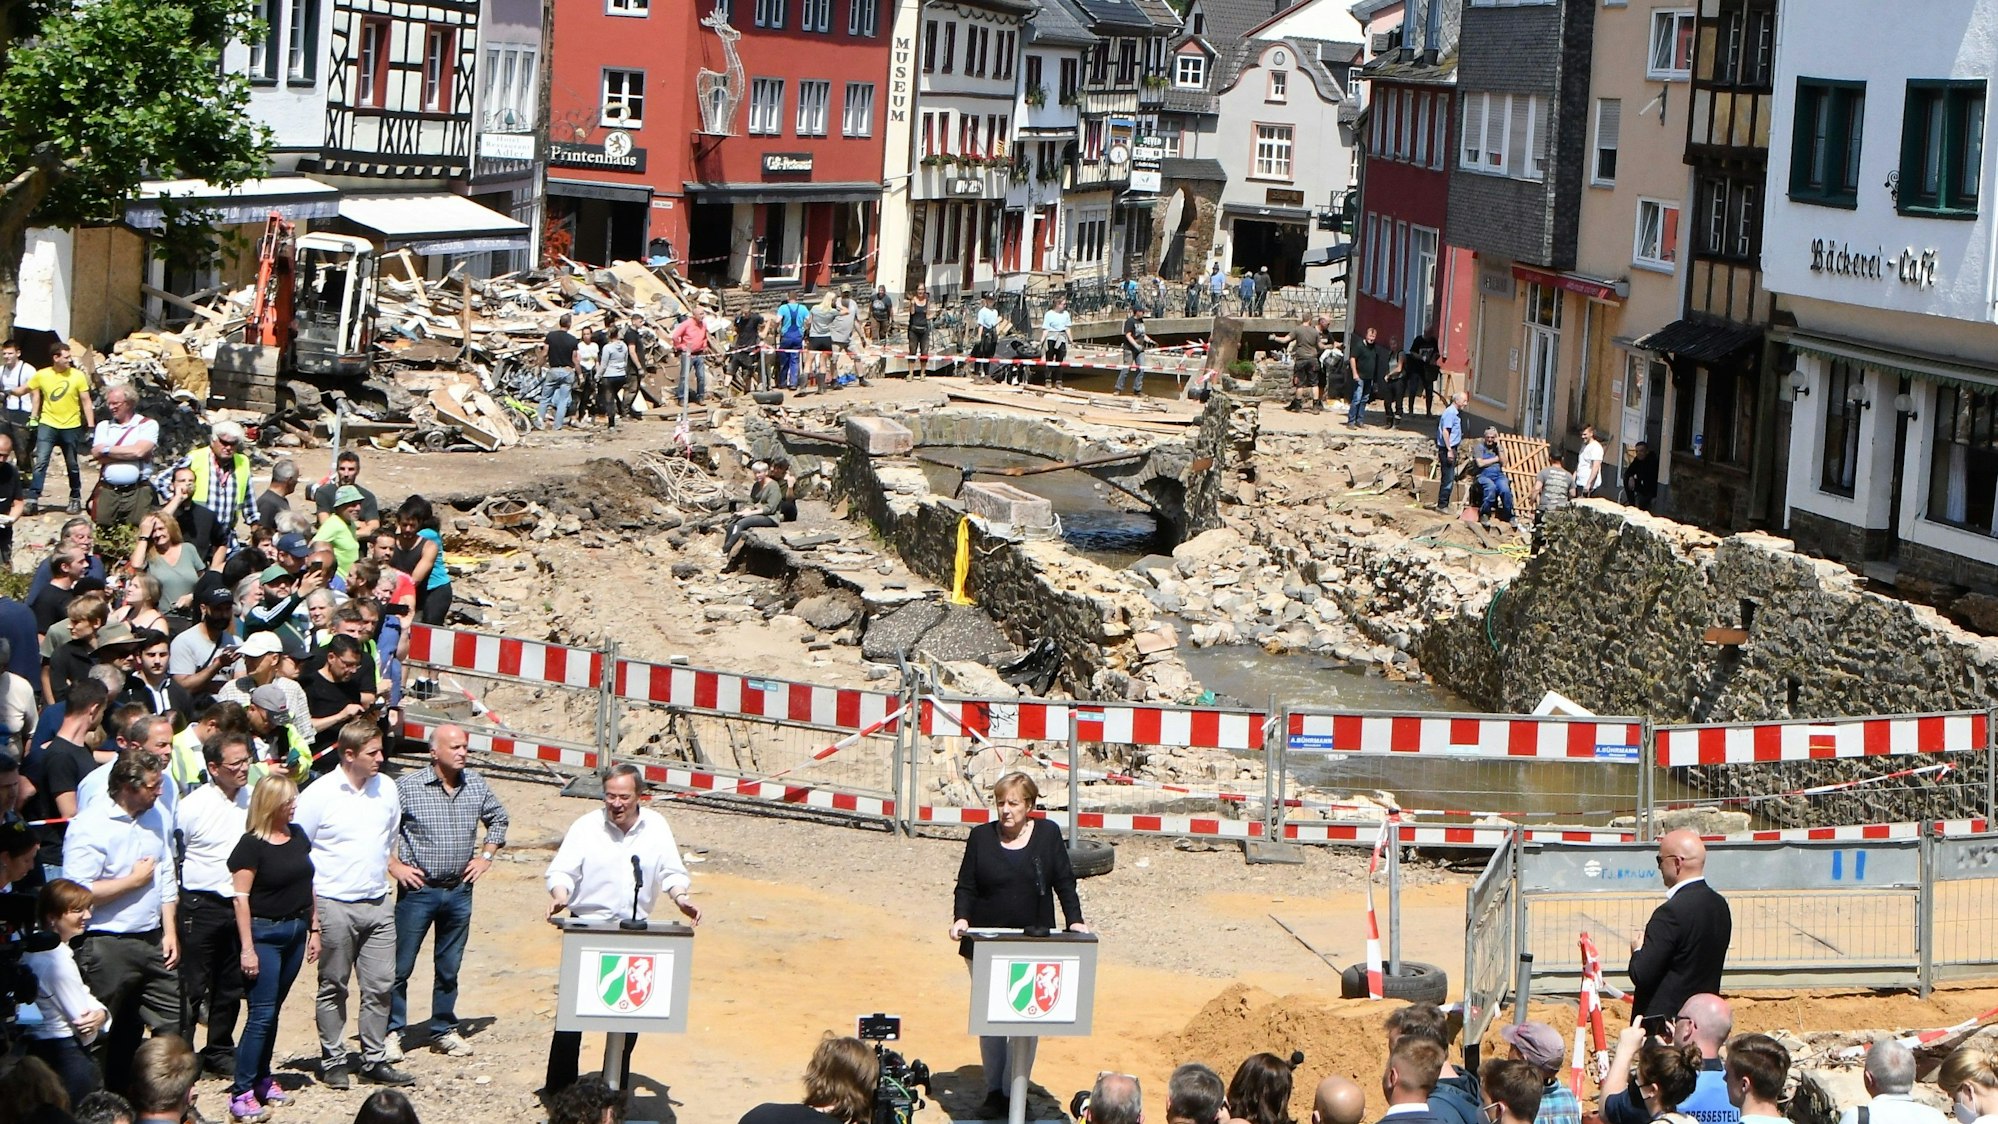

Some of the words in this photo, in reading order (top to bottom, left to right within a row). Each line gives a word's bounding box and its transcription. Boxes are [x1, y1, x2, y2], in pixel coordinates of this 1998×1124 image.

[890, 37, 910, 122] MUSEUM
[495, 149, 524, 158] Adler
[550, 145, 637, 167] Printenhaus
